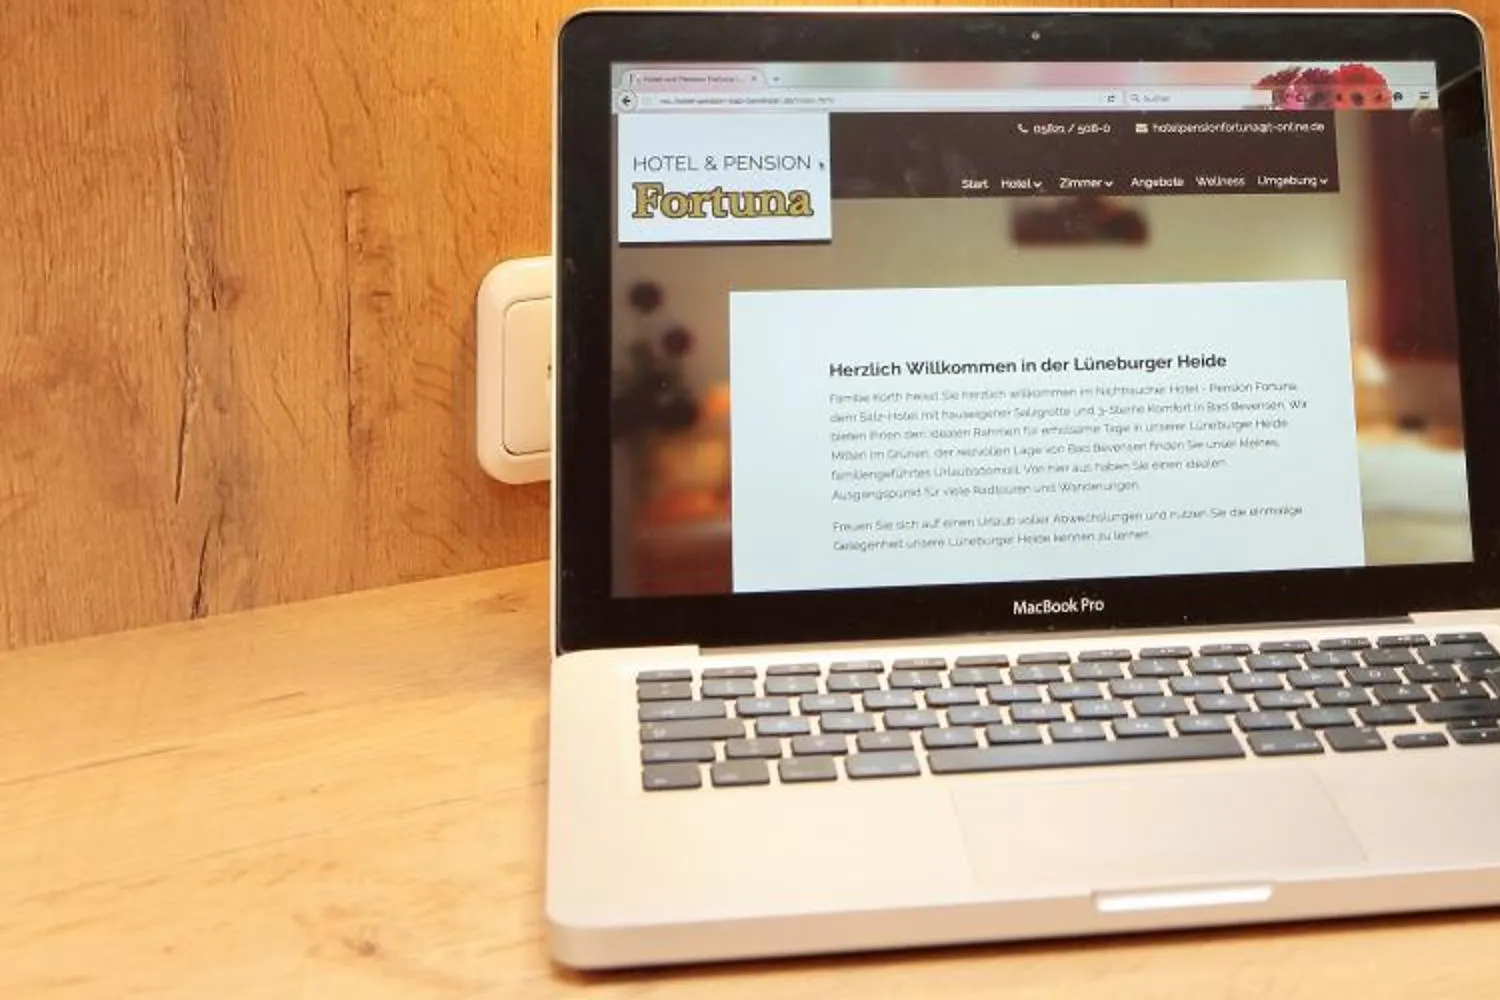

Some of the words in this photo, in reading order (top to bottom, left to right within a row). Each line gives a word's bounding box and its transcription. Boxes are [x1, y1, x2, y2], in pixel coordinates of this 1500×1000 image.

[633, 155, 698, 172] HOTEL
[704, 154, 718, 171] &
[723, 154, 812, 171] PENSION
[961, 178, 989, 190] Start
[1001, 177, 1032, 190] Hotel
[1059, 177, 1103, 189] Zimmer
[1130, 176, 1185, 190] Angebote
[1195, 175, 1246, 188] Wellness
[1257, 175, 1317, 189] Umgebung
[631, 181, 815, 219] Fortuna
[829, 360, 901, 377] Herzlich
[905, 359, 1017, 377] Willkommen
[1021, 358, 1037, 374] in
[1040, 357, 1070, 373] der
[1074, 354, 1173, 373] Lüneburger
[1177, 353, 1228, 370] Heide
[1013, 597, 1079, 615] MacBook
[1081, 596, 1105, 612] Pro
